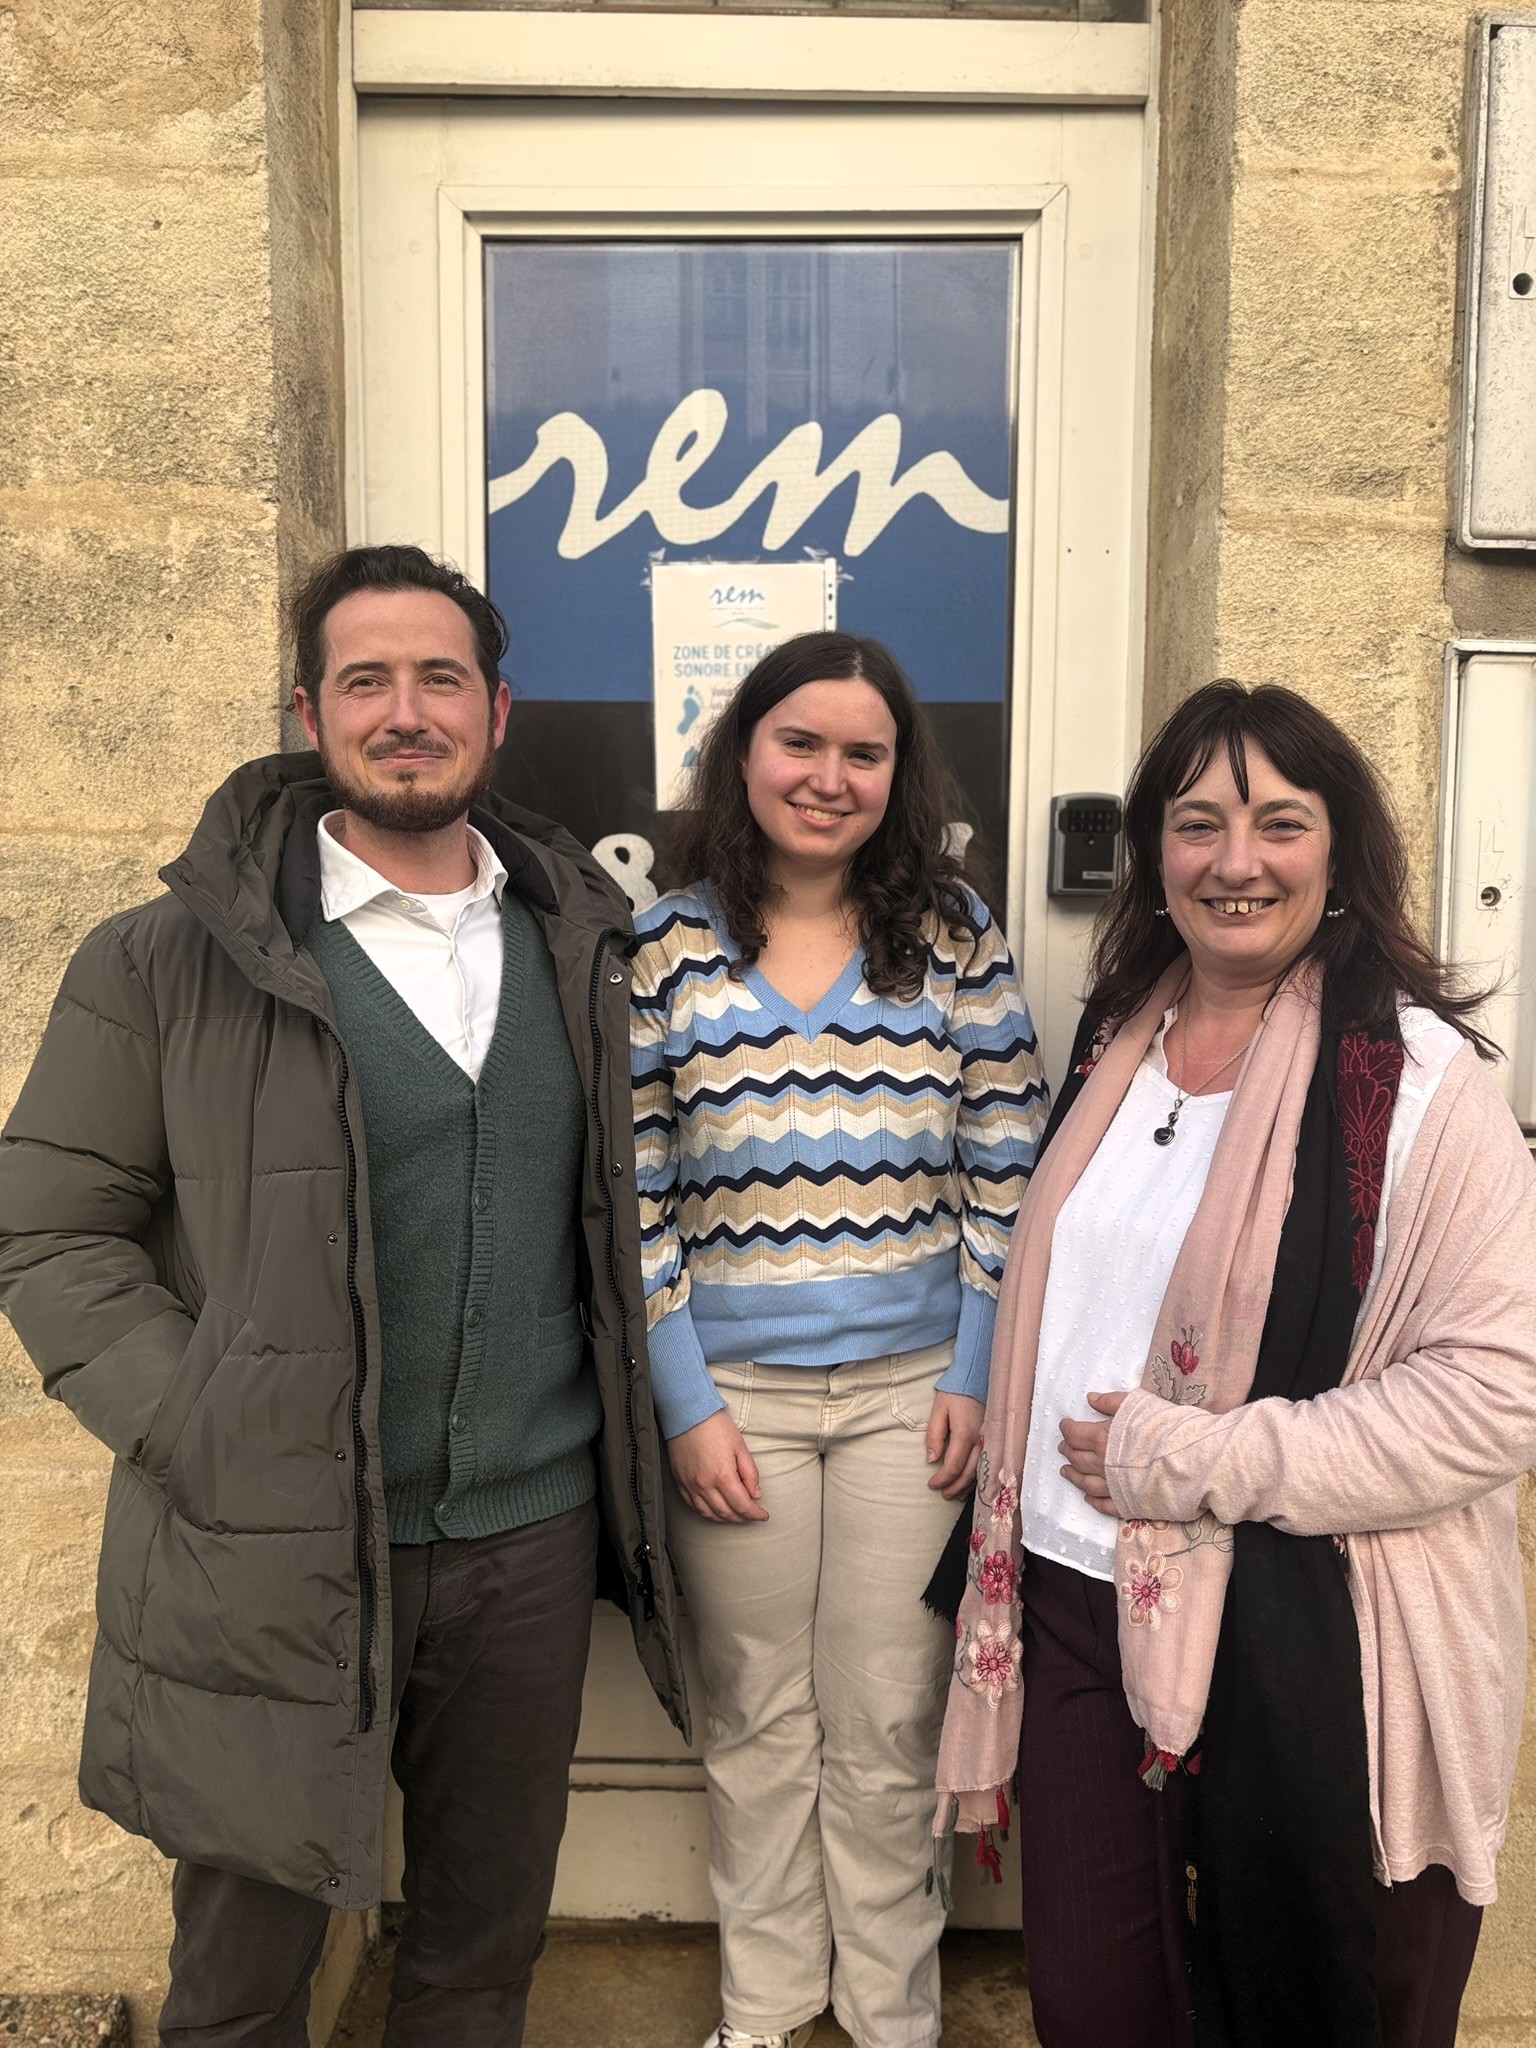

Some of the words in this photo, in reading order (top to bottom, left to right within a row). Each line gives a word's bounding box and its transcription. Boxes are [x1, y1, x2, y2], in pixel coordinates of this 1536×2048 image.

[489, 388, 1008, 559] rem
[710, 585, 766, 605] rem
[673, 645, 711, 660] ZONE
[713, 645, 732, 660] DE
[674, 662, 731, 678] SONORE
